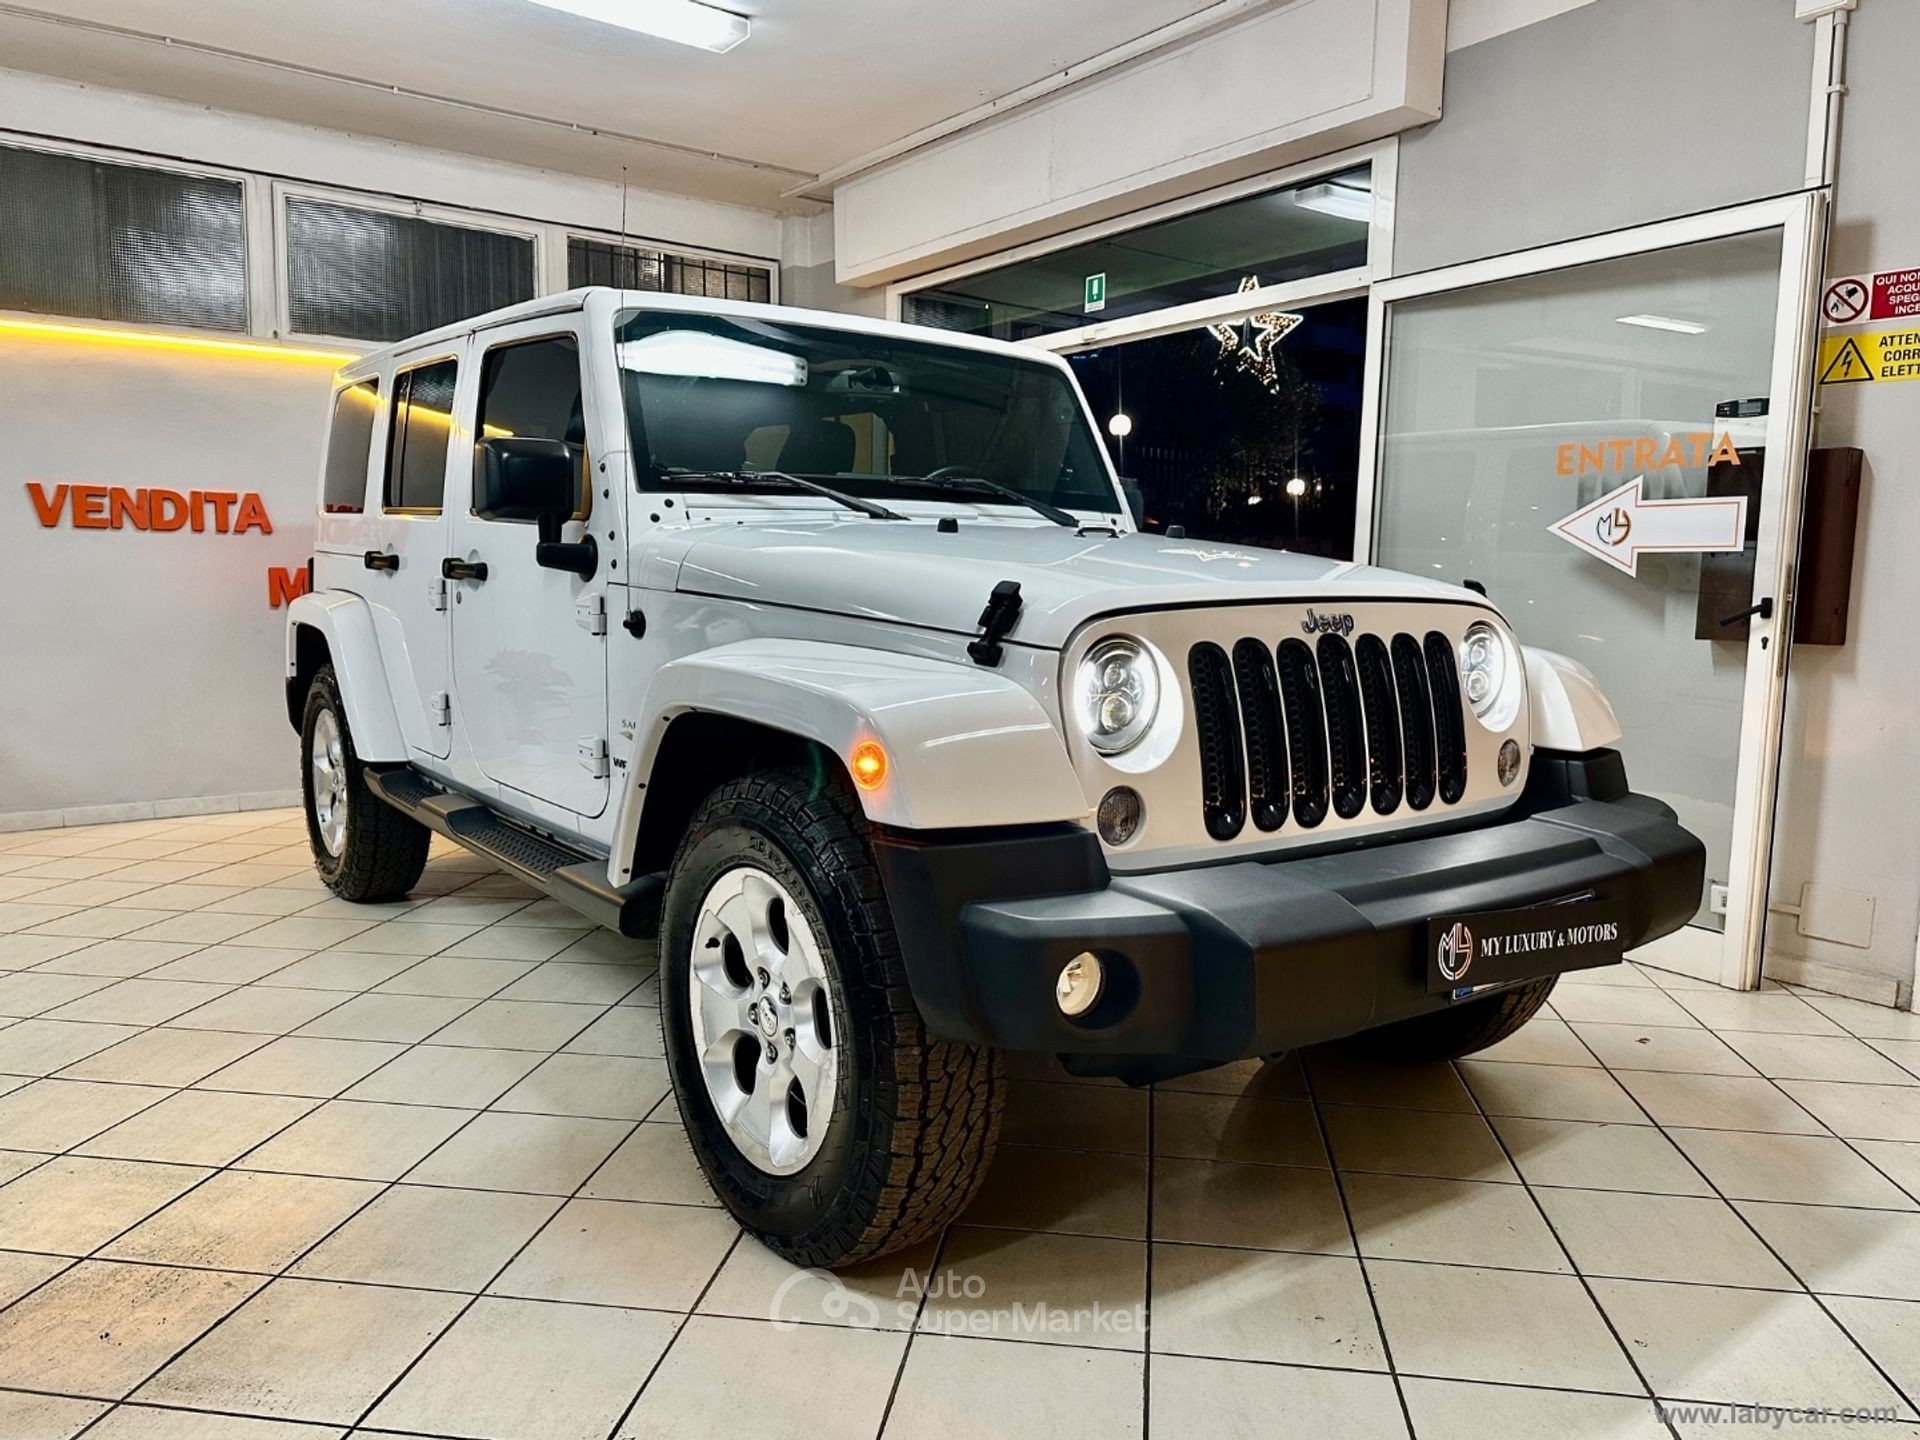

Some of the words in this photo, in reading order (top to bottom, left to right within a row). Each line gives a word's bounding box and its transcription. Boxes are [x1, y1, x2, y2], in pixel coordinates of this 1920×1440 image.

[1876, 274, 1897, 286] QUI
[1887, 282, 1920, 295] ACQU
[1889, 293, 1920, 305] SPEG
[1895, 303, 1920, 315] INCE
[1884, 348, 1920, 362] CORR
[1557, 431, 1741, 476] ENTRATA
[26, 482, 273, 534] VENDITA
[1301, 608, 1354, 637] Jeep
[1481, 937, 1503, 958] MY
[1504, 929, 1557, 954] LUXURY
[1557, 933, 1566, 948] &
[1566, 922, 1618, 947] MOTORS
